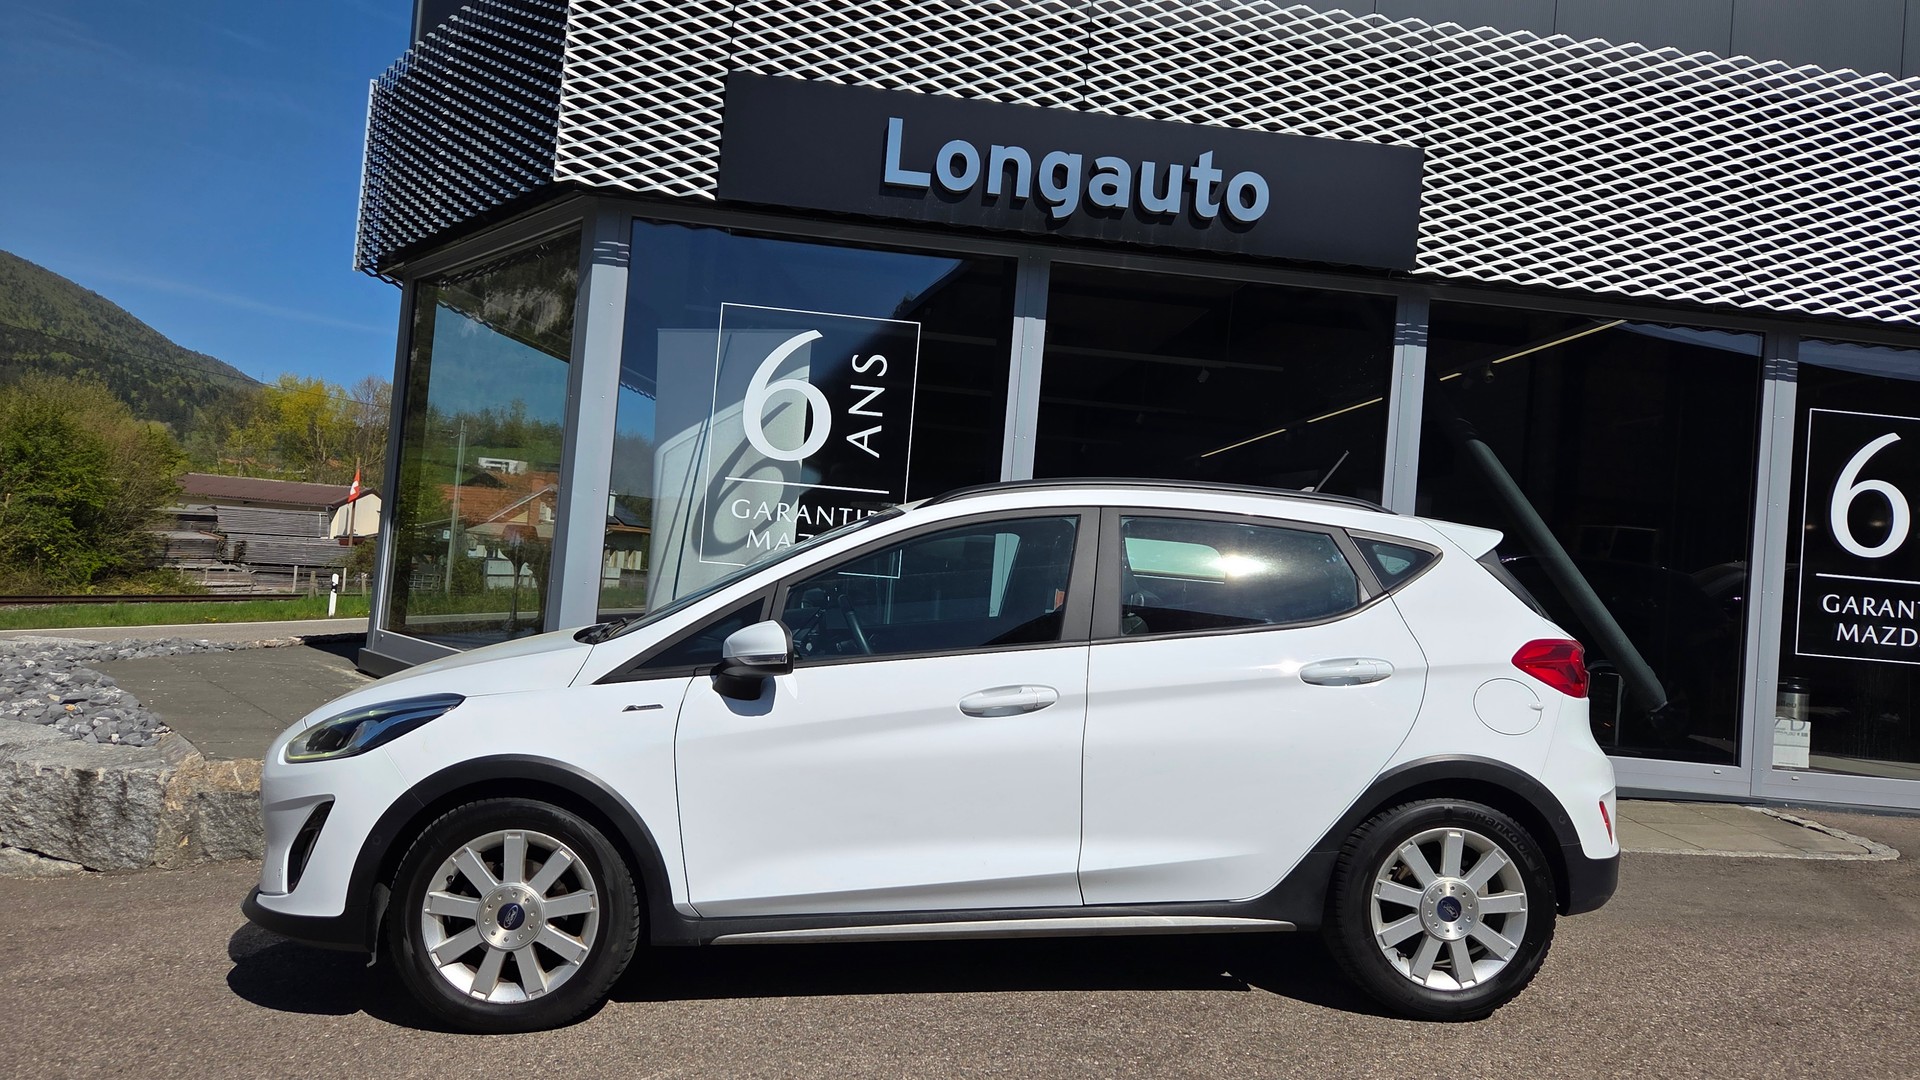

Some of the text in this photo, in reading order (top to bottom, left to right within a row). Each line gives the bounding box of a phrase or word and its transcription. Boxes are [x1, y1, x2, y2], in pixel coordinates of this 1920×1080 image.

[884, 116, 1270, 222] Longauto
[743, 329, 832, 461] 6
[846, 354, 888, 459] ANS
[731, 499, 879, 527] GARANTI
[1830, 432, 1911, 558] 6
[1822, 593, 1920, 620] GARAN
[1836, 622, 1920, 647] MAZD
